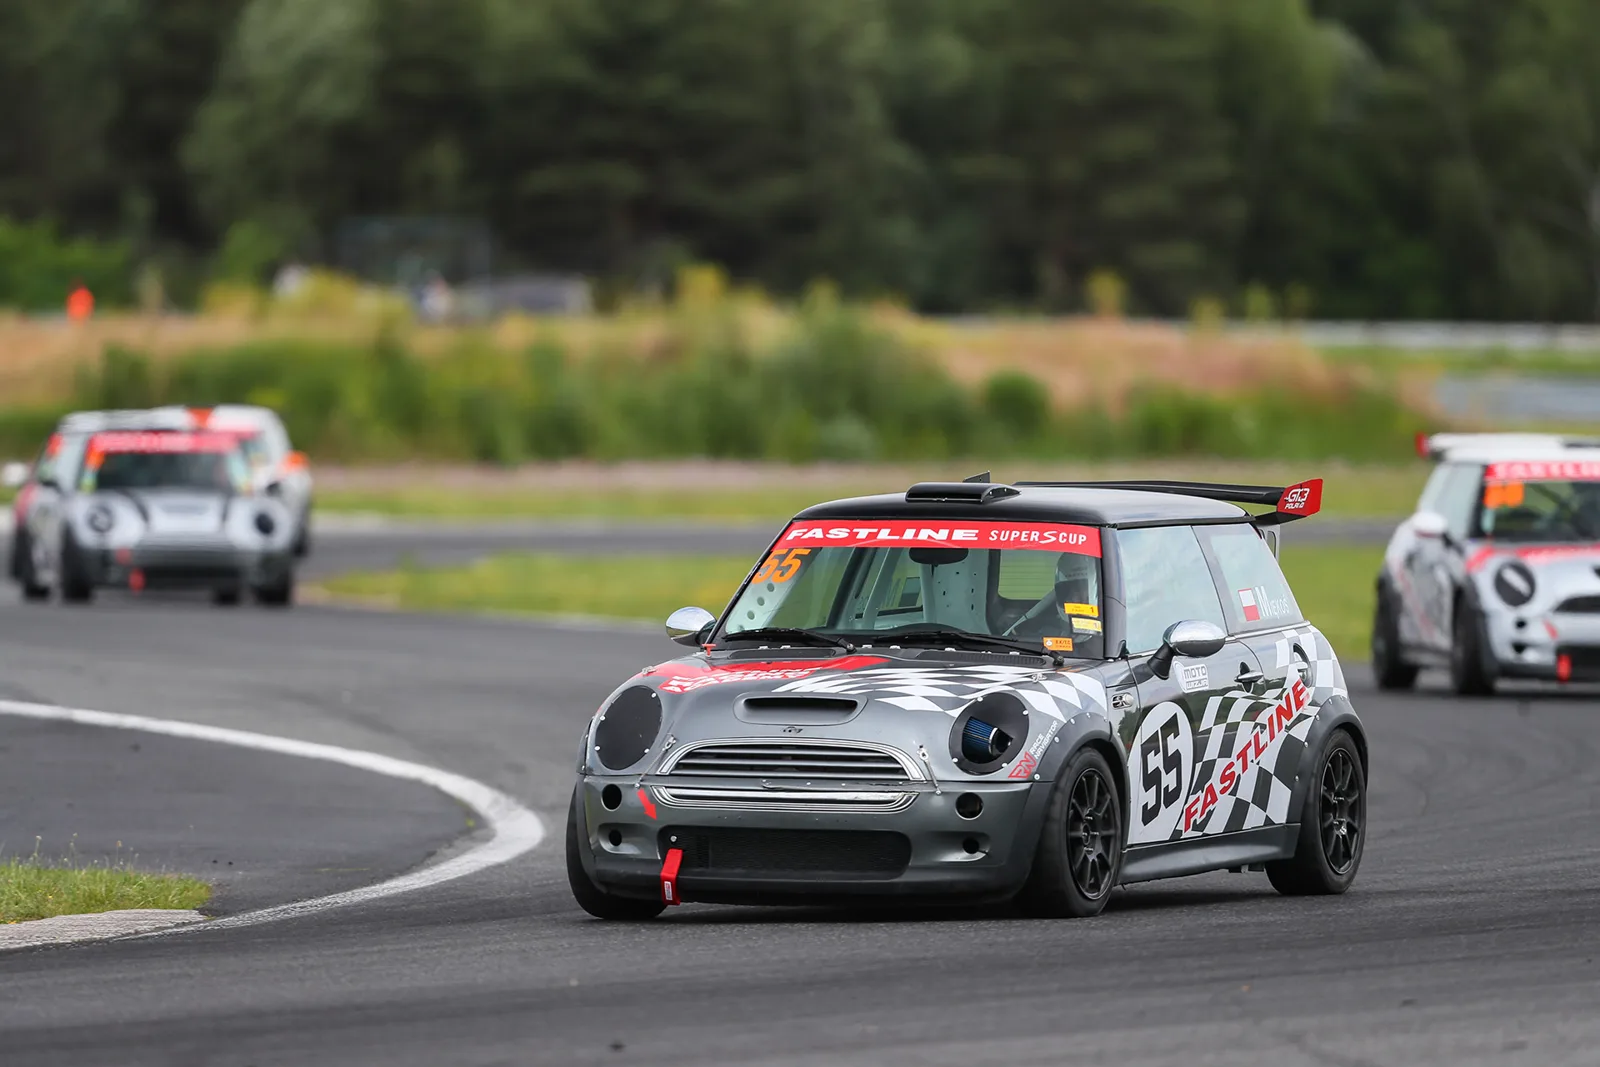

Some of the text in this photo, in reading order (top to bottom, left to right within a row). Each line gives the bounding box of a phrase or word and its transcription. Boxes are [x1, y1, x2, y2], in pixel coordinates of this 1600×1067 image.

[1284, 488, 1310, 502] GT3
[786, 527, 979, 541] FASTLINE
[752, 548, 811, 584] 55
[1184, 666, 1206, 679] MOTO
[1030, 733, 1045, 755] RACE
[1033, 720, 1058, 760] NAVIGATOR
[1141, 713, 1182, 826] 55
[1184, 677, 1309, 833] FASTLINE
